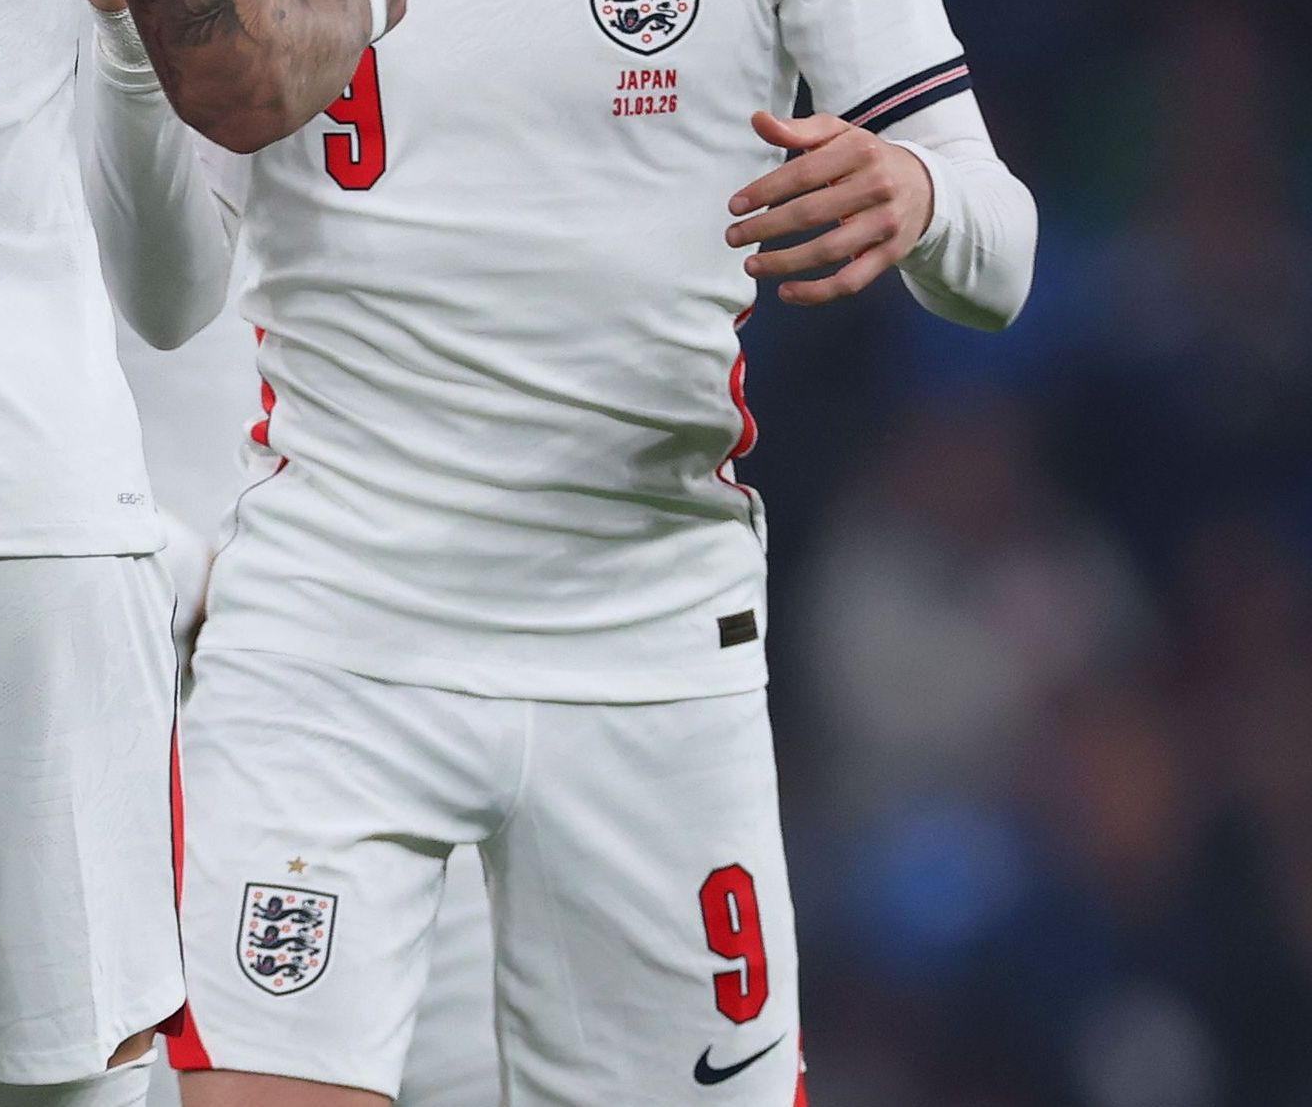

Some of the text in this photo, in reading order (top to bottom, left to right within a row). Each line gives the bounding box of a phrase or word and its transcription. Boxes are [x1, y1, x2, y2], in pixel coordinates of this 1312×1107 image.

[616, 69, 677, 91] JAPAN
[612, 94, 678, 117] 31.03.26
[698, 863, 770, 1026] 9
